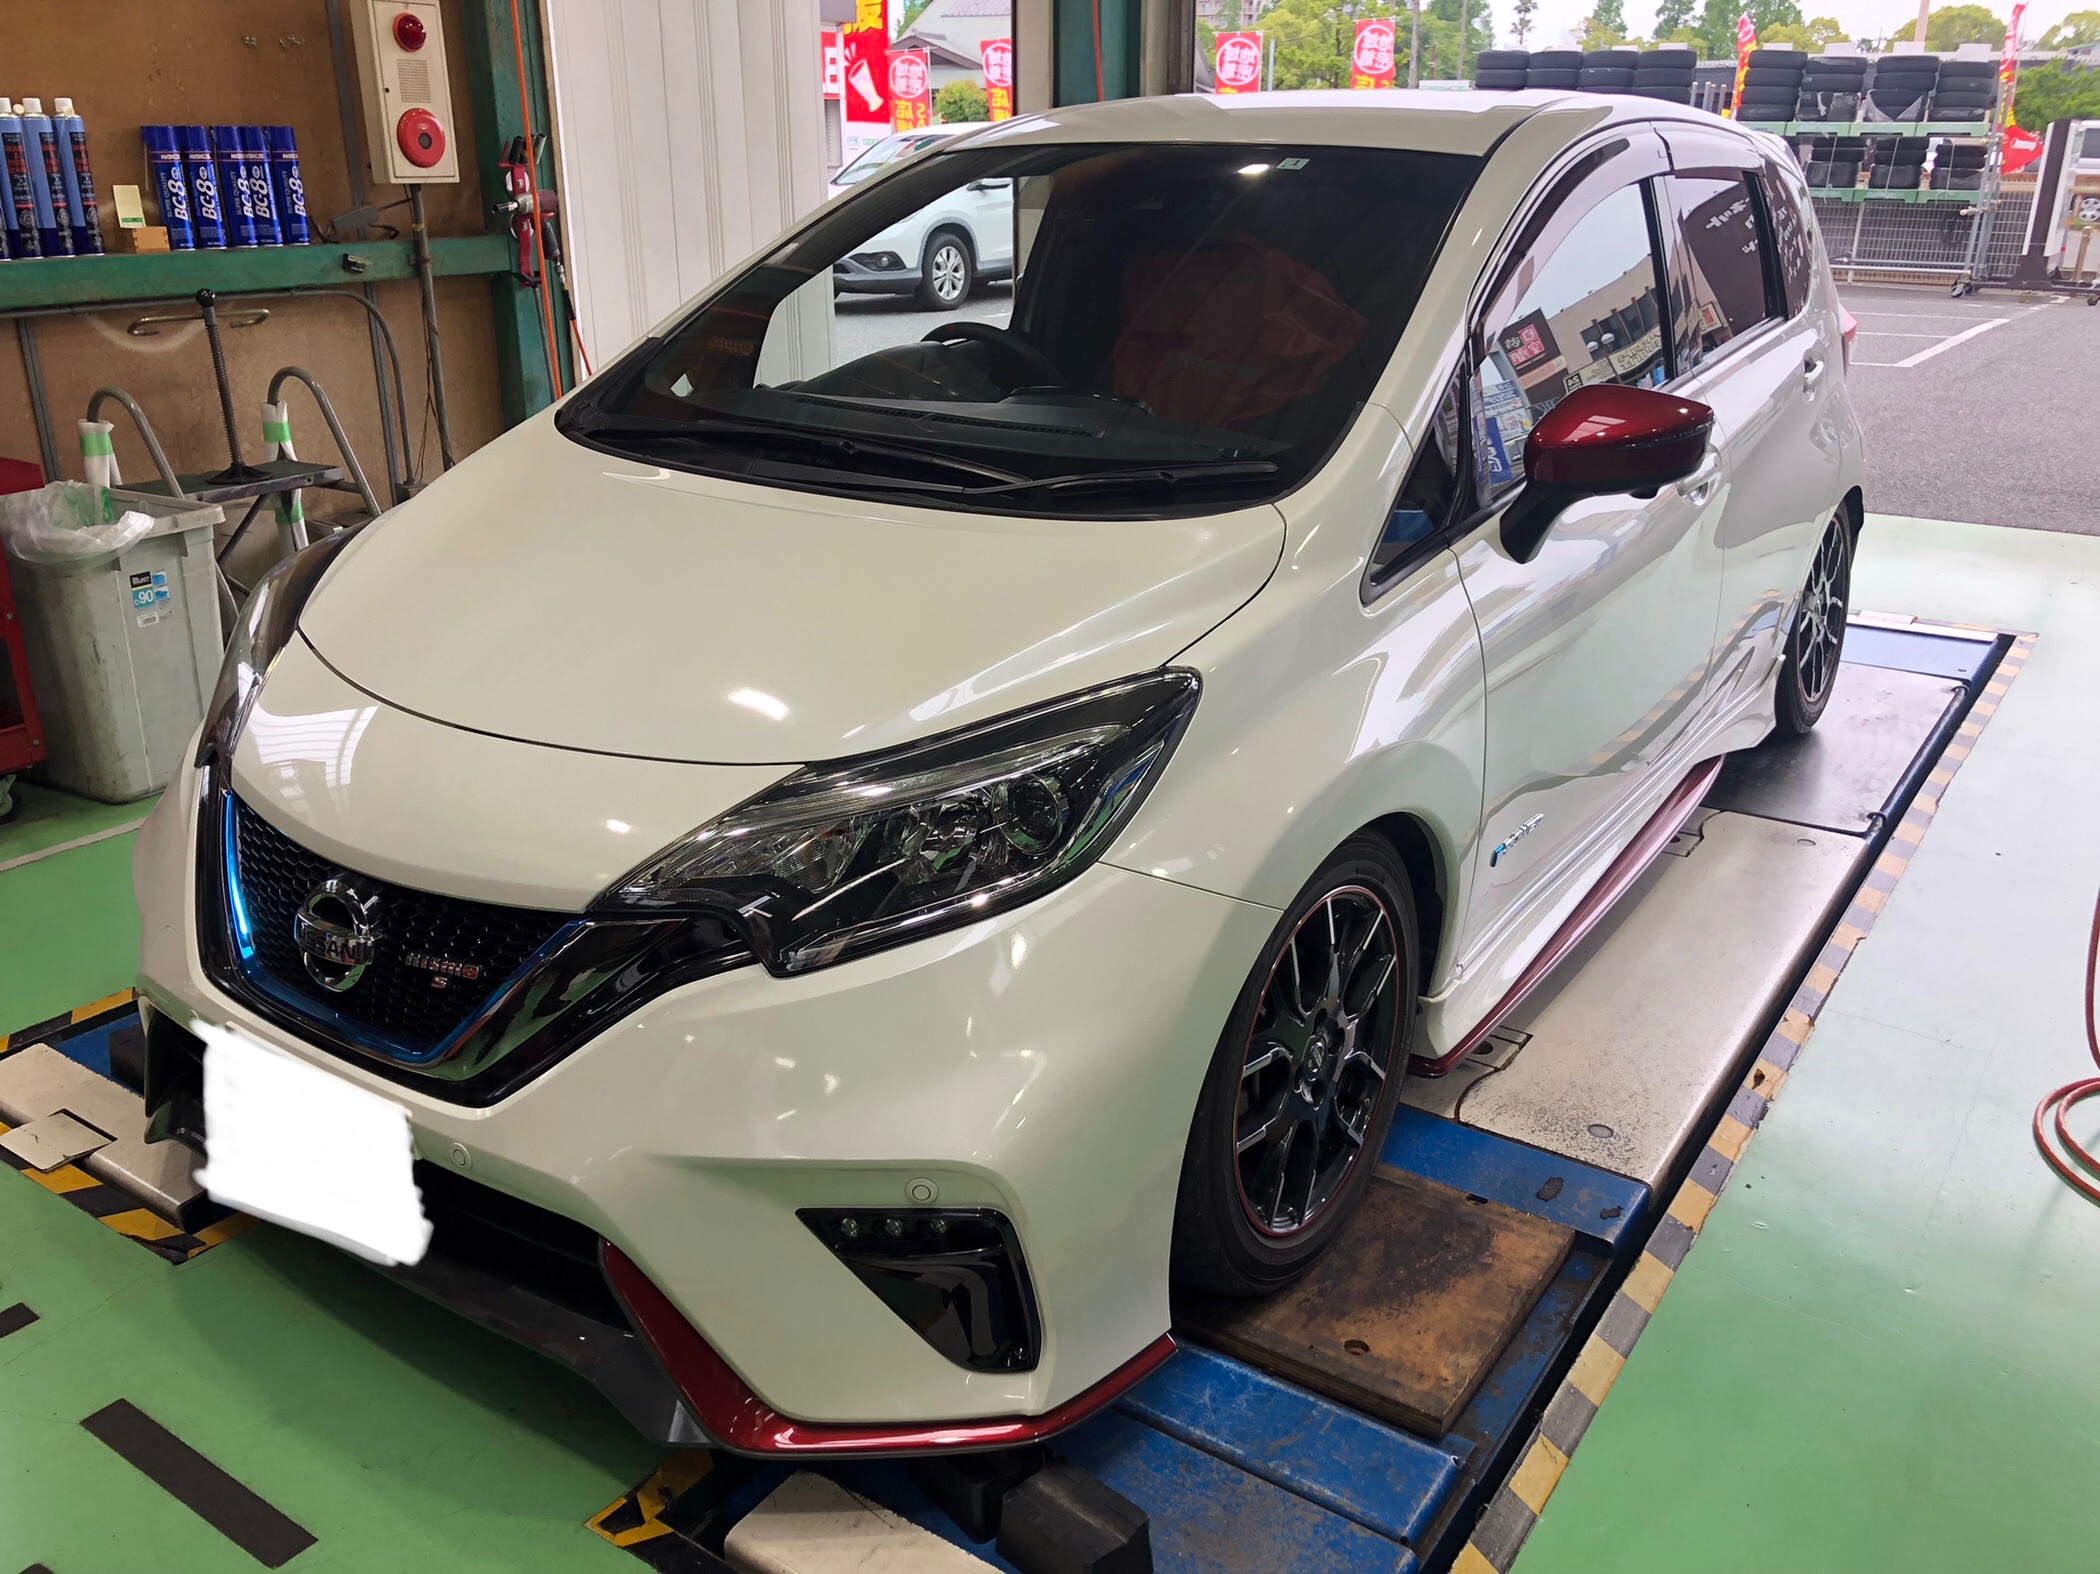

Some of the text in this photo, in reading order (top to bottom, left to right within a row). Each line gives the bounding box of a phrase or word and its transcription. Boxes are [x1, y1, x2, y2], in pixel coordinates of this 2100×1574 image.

[167, 178, 189, 221] BC-8
[196, 178, 218, 220] BC-8
[237, 178, 254, 218] BC-8
[249, 178, 270, 219] BC-8
[288, 177, 307, 217] BC-8
[138, 589, 154, 604] 90
